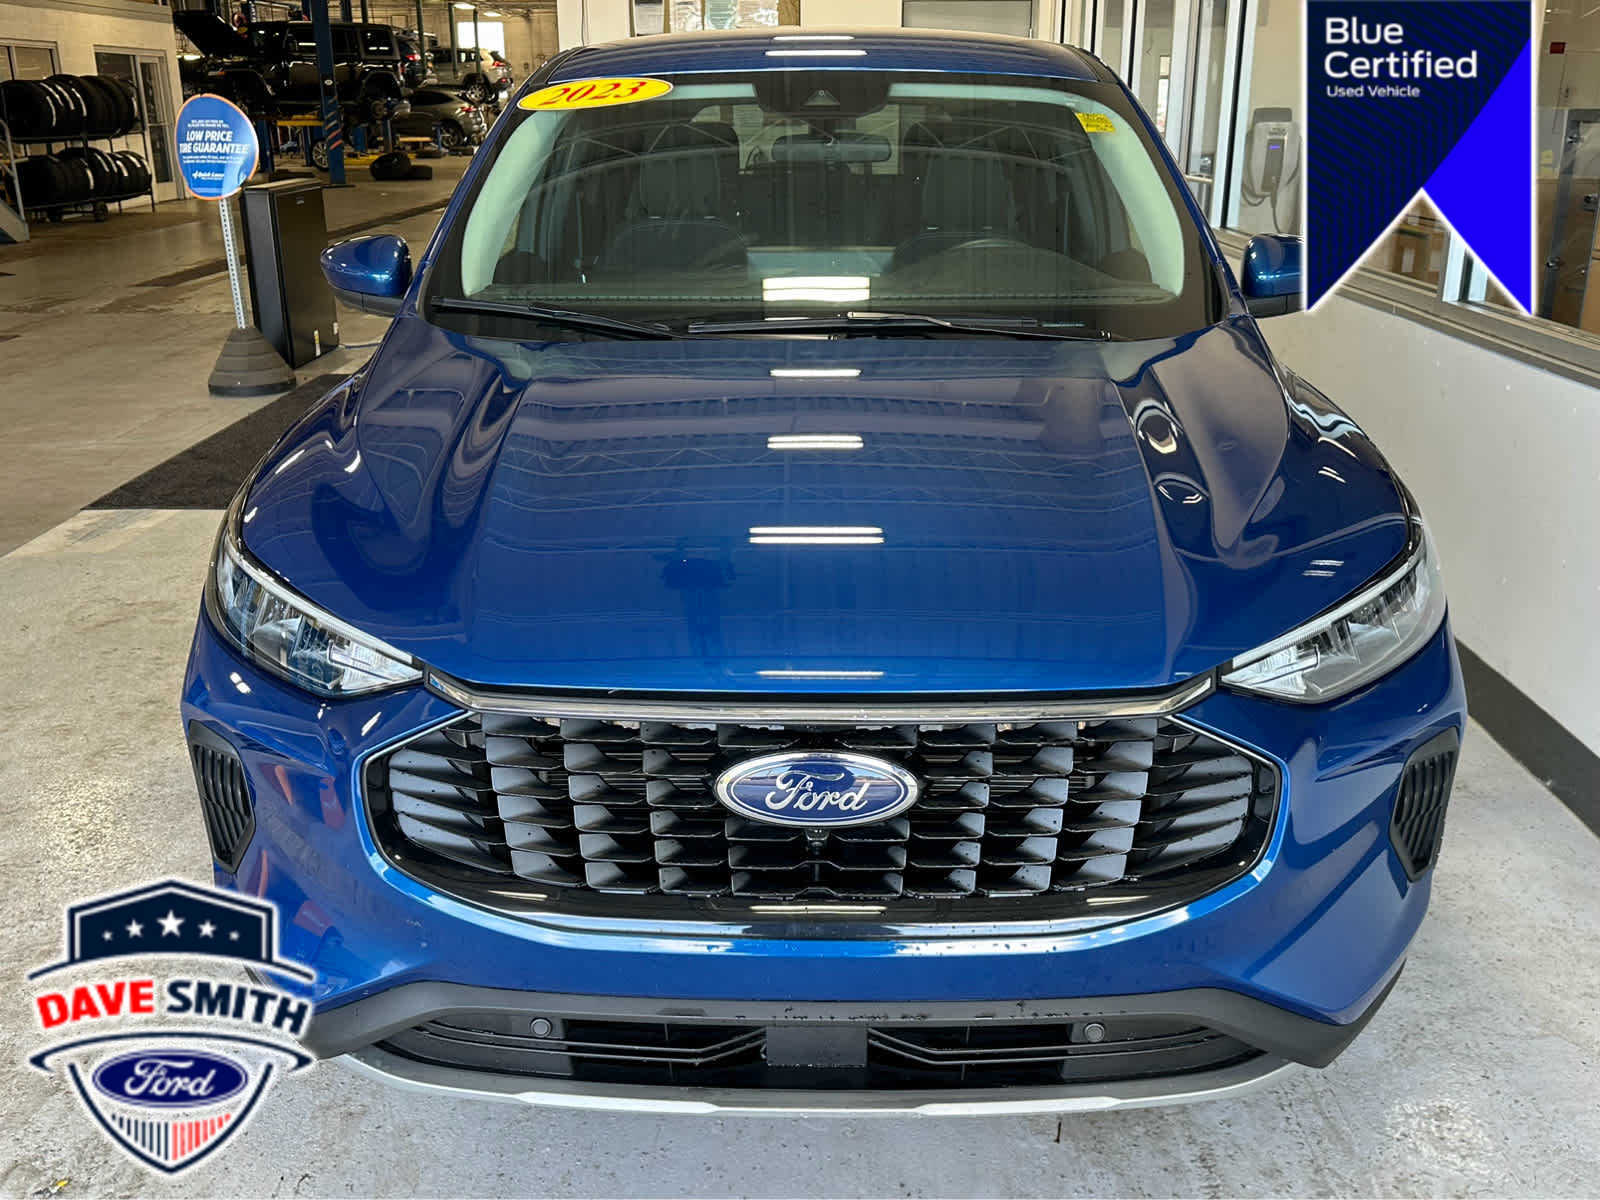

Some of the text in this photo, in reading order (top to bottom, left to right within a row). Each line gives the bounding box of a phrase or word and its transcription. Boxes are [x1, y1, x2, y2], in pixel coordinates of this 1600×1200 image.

[538, 81, 647, 106] 2023
[186, 130, 233, 142] LOW PRICE
[193, 142, 249, 154] GUARANTEE
[765, 769, 870, 811] Ford
